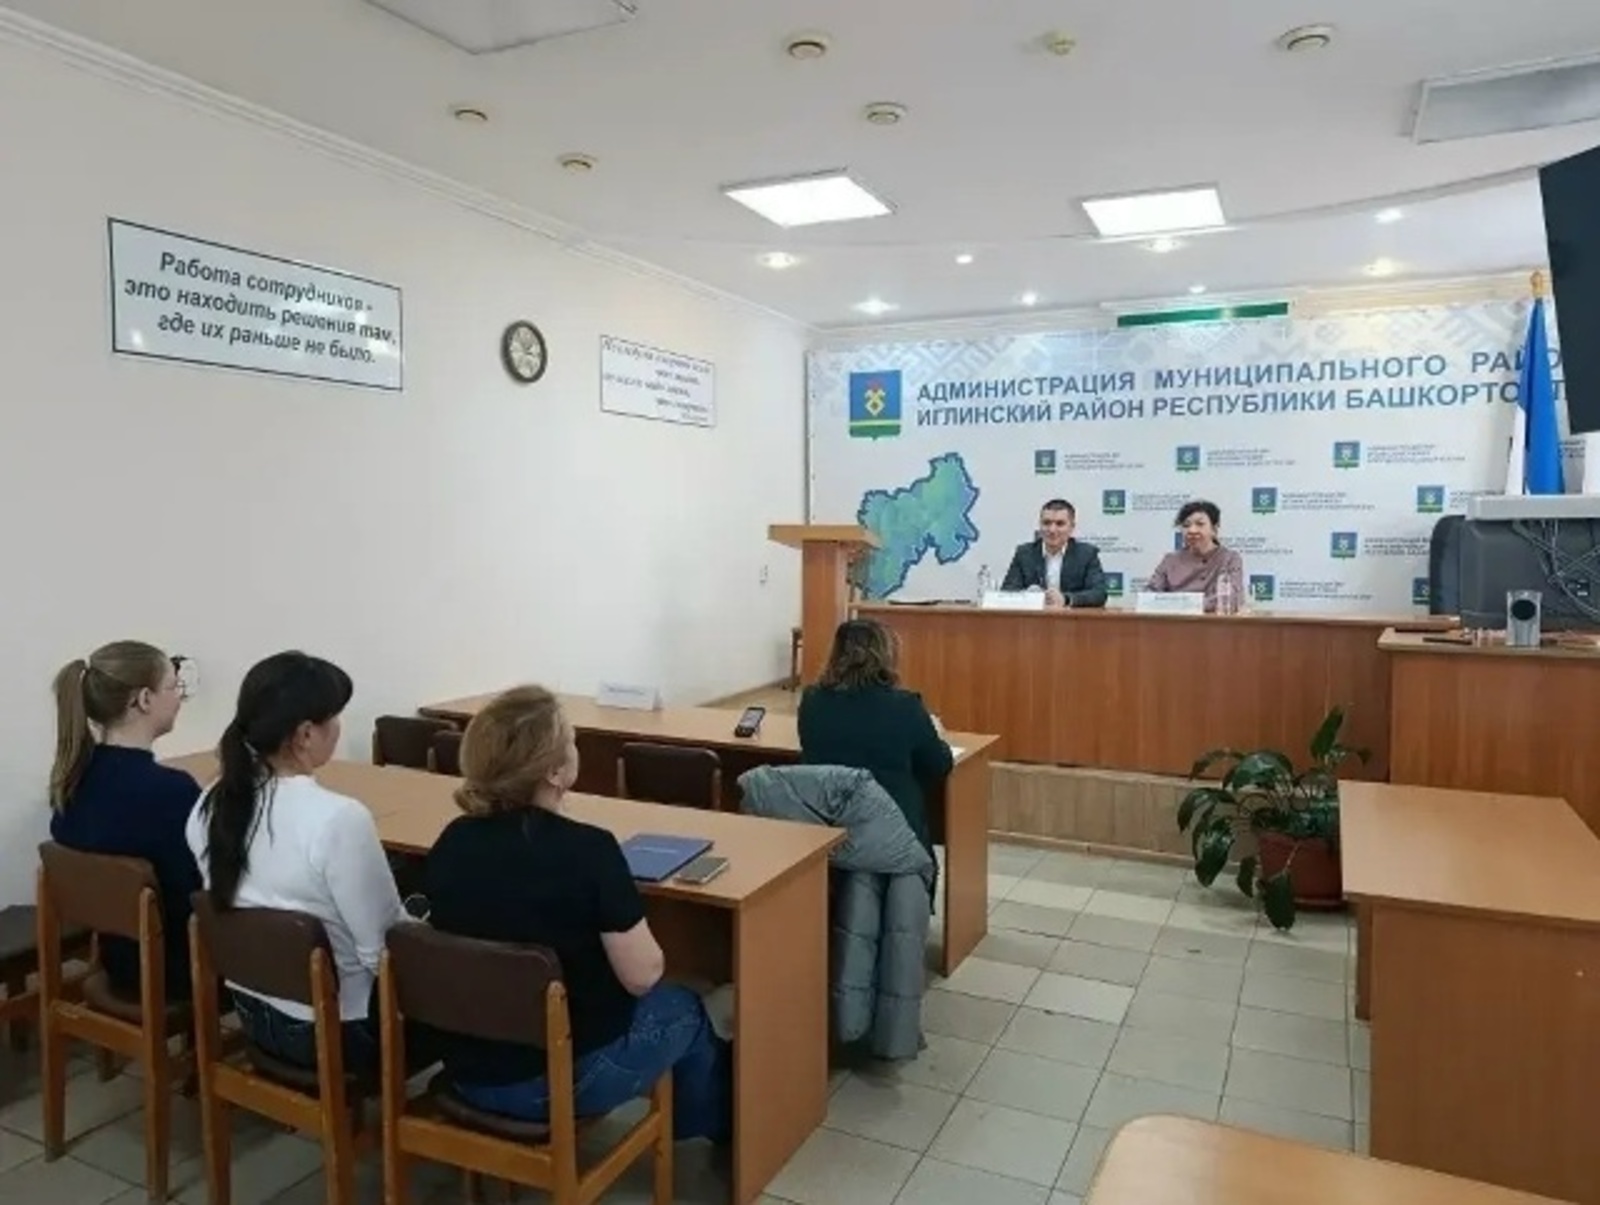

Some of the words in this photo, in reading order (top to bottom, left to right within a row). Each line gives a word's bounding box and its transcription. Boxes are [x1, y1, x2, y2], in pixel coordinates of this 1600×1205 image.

[160, 251, 241, 287] Работа
[246, 273, 363, 311] сотрудников
[124, 278, 171, 302] это
[176, 289, 276, 322] находить
[281, 308, 356, 335] решения
[157, 312, 196, 334] где
[200, 322, 224, 339] их
[229, 326, 301, 351] раньше
[304, 339, 326, 355] не
[917, 372, 1136, 403] АДМИНИСТРАЦИЯ
[1154, 354, 1446, 388] МУНИЦИПАЛЬНОГО
[917, 400, 1051, 427] ИГЛИНСКИЙ
[1059, 397, 1145, 422] РАЙОН
[1152, 391, 1336, 418] РЕСПУБЛИКИ
[1345, 379, 1567, 410] БАШКОРТОТ
